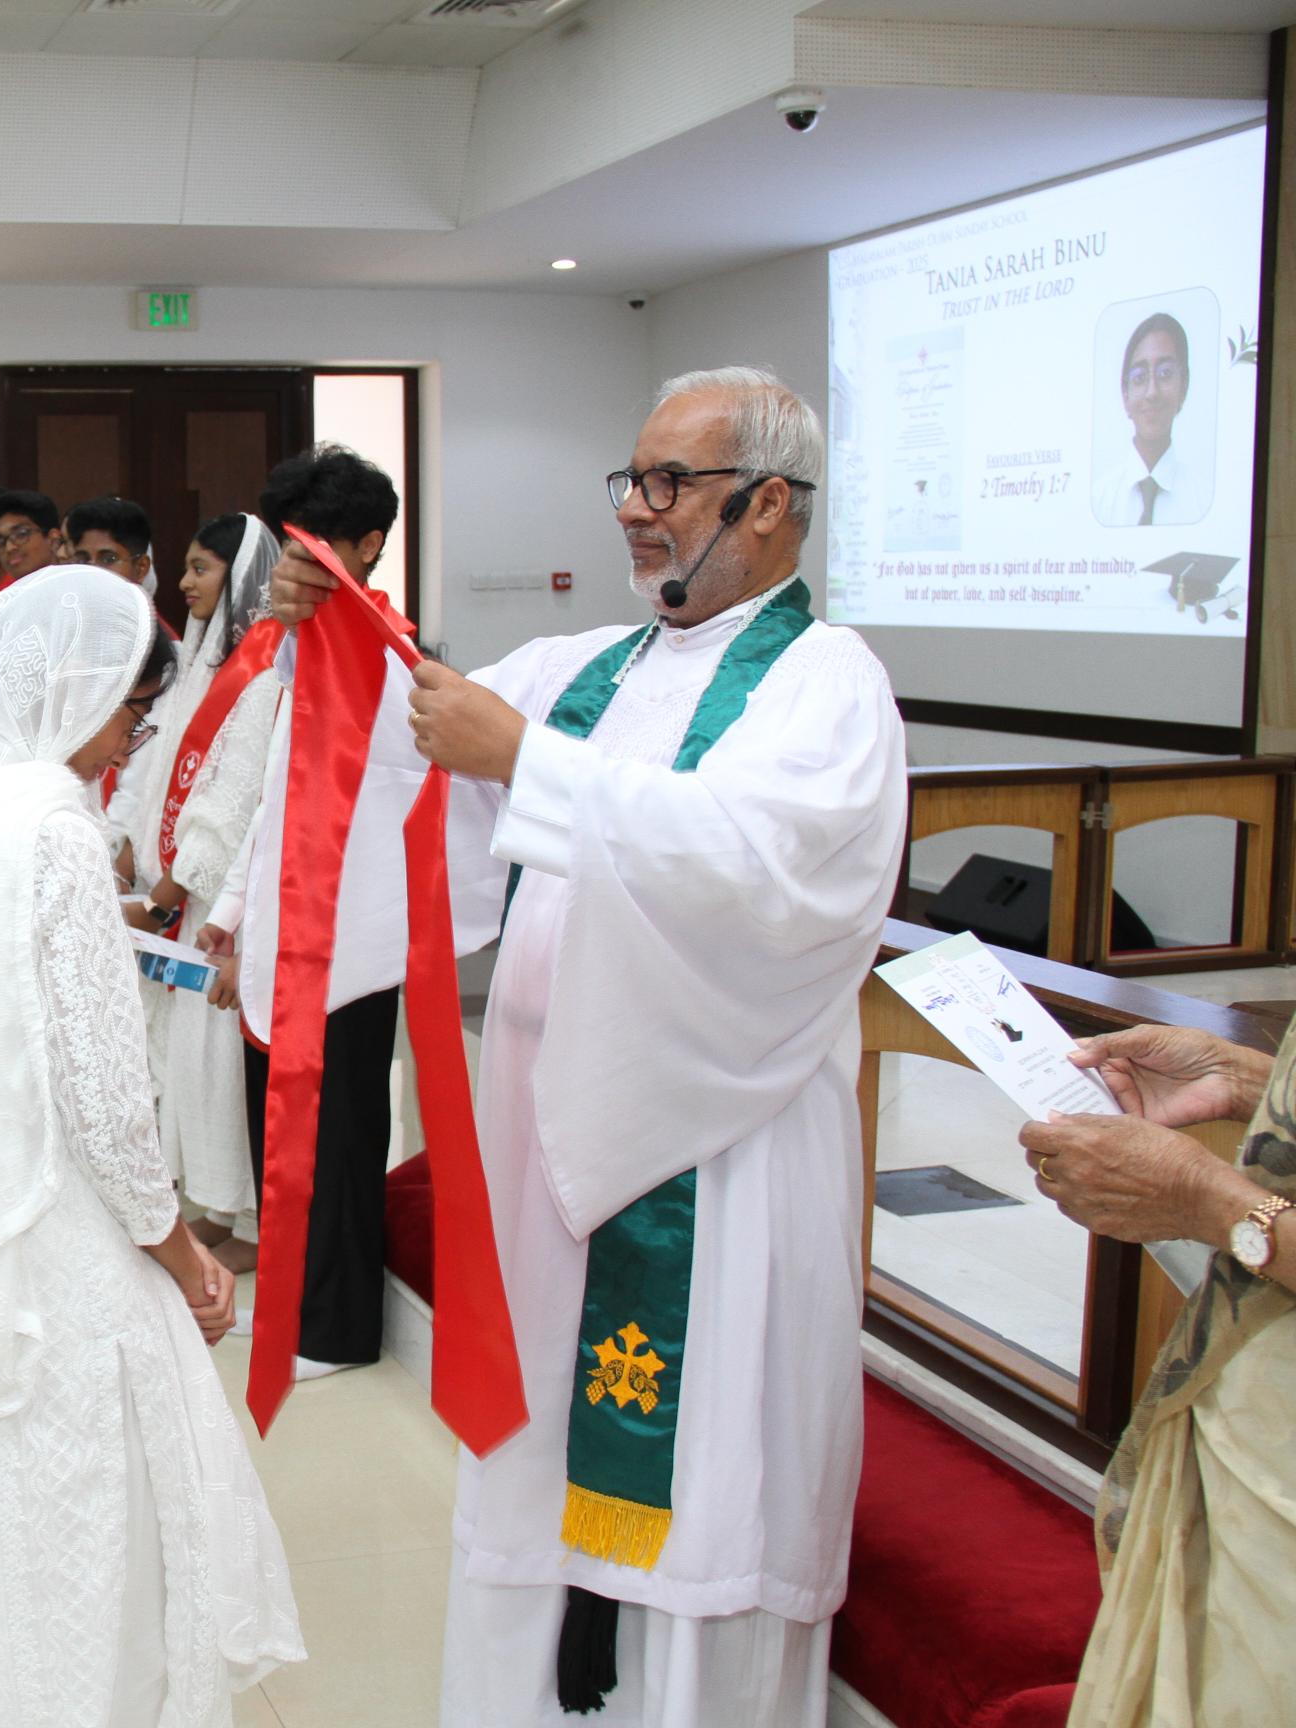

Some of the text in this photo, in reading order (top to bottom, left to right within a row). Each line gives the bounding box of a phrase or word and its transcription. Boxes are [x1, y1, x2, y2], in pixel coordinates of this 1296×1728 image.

[991, 209, 1029, 231] SCHOOL
[925, 231, 1107, 295] TANIA SARAH BINU
[149, 293, 191, 326] EXIT
[941, 277, 1076, 321] TRUST IN THE LORD
[979, 471, 1072, 503] 2 Timothy 1:7
[917, 560, 932, 576] has
[952, 561, 977, 579] given
[979, 562, 991, 576] us
[1001, 560, 1029, 578] spirit
[1068, 557, 1088, 575] and
[988, 585, 1006, 602] and
